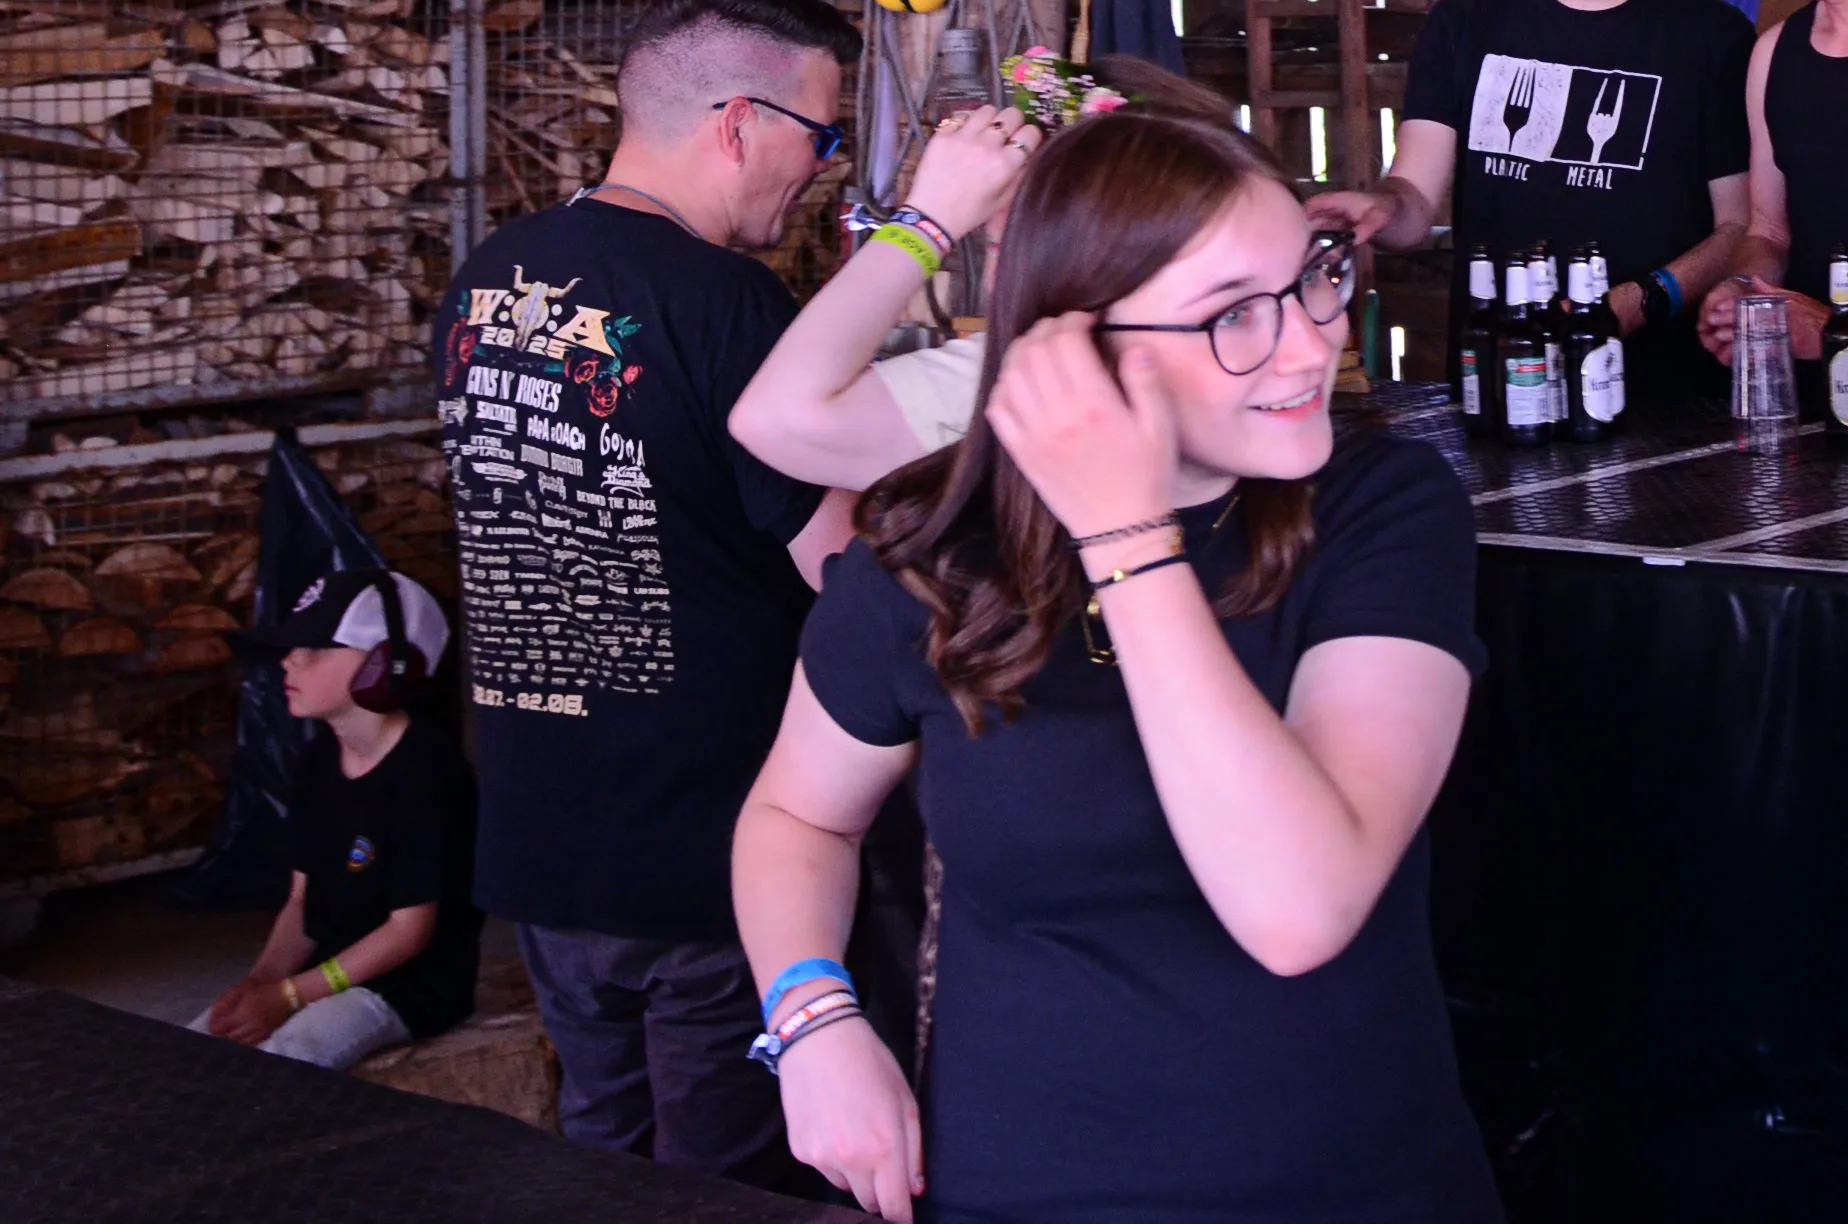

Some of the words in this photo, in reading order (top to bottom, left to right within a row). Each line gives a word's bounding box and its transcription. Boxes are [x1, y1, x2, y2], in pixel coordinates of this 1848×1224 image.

[1566, 166, 1613, 190] METAL
[514, 374, 564, 414] ROSES
[527, 415, 549, 442] PAPA
[551, 422, 586, 451] ROACH
